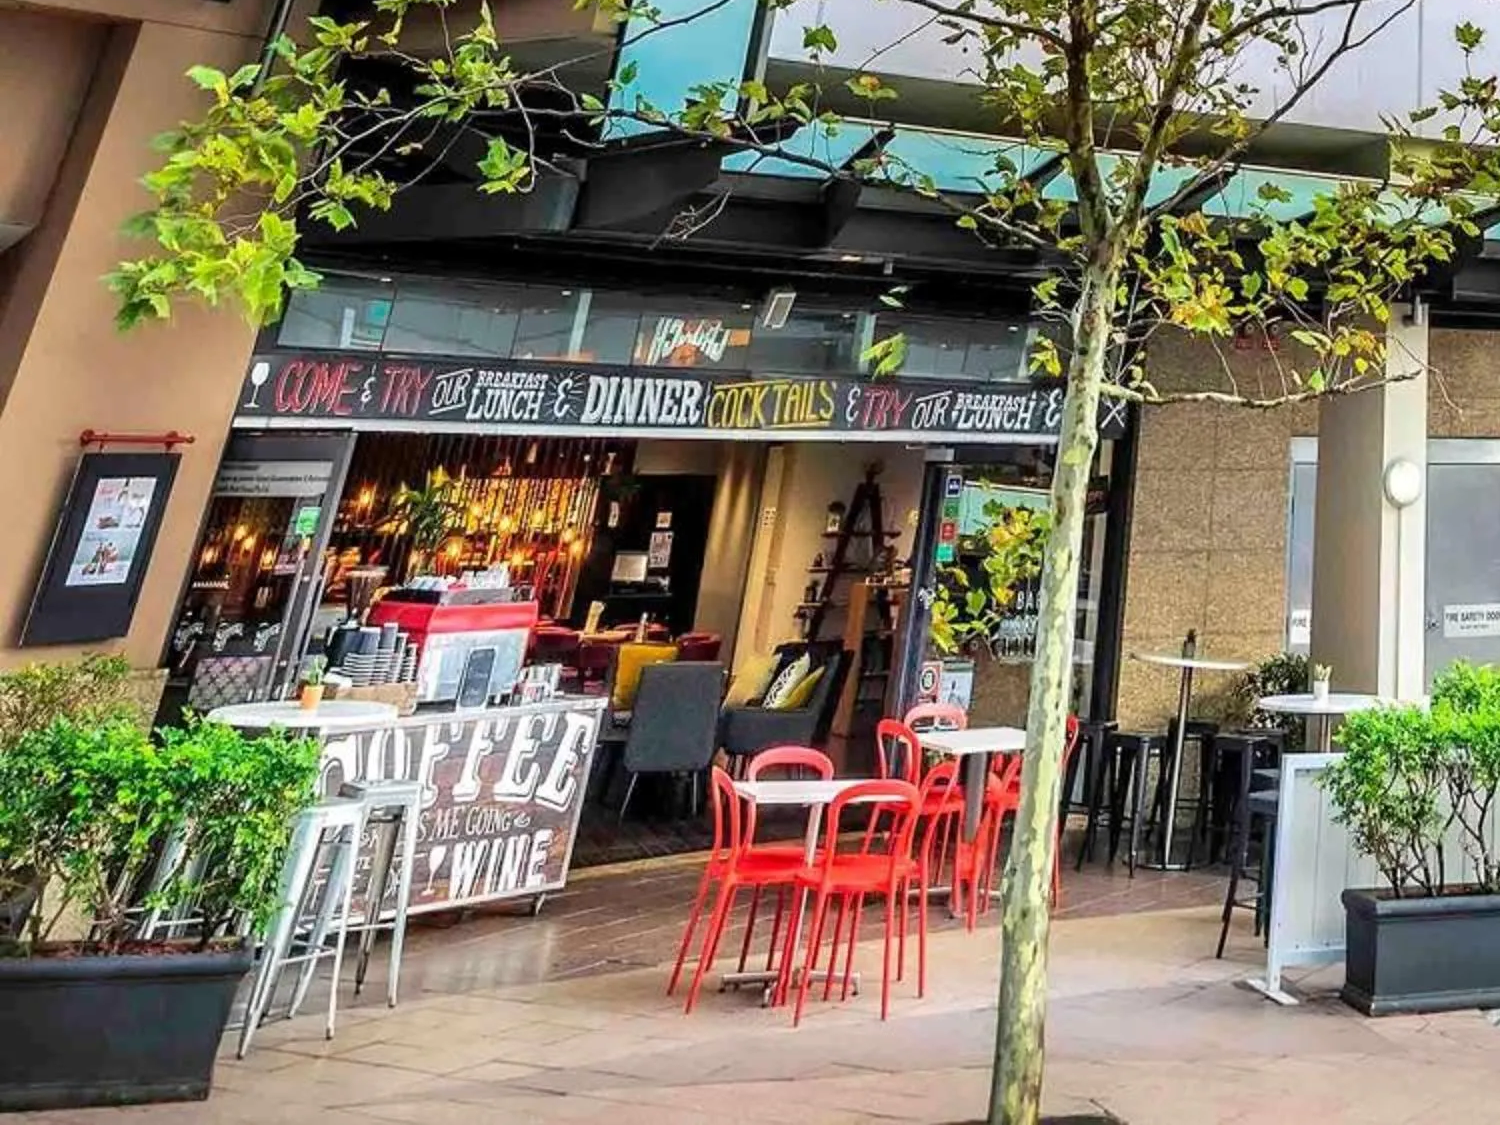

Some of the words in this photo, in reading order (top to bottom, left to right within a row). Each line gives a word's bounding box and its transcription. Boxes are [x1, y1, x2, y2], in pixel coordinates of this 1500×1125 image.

[275, 357, 363, 415] COME
[361, 363, 376, 411] &
[380, 362, 434, 415] TRY
[432, 371, 471, 408] OUR
[476, 370, 549, 389] BREAKFAST
[465, 388, 545, 420] LUNCH
[553, 378, 573, 418] &
[580, 375, 701, 426] DINNER
[708, 380, 837, 428] COCKTAILS
[846, 386, 861, 423] &
[863, 385, 914, 428] TRY
[911, 395, 950, 430] OUR
[957, 402, 1037, 430] LUNCH
[1460, 611, 1485, 622] SAFETY
[428, 805, 461, 842] ME
[465, 806, 511, 835] GOING
[448, 828, 554, 900] WINE
